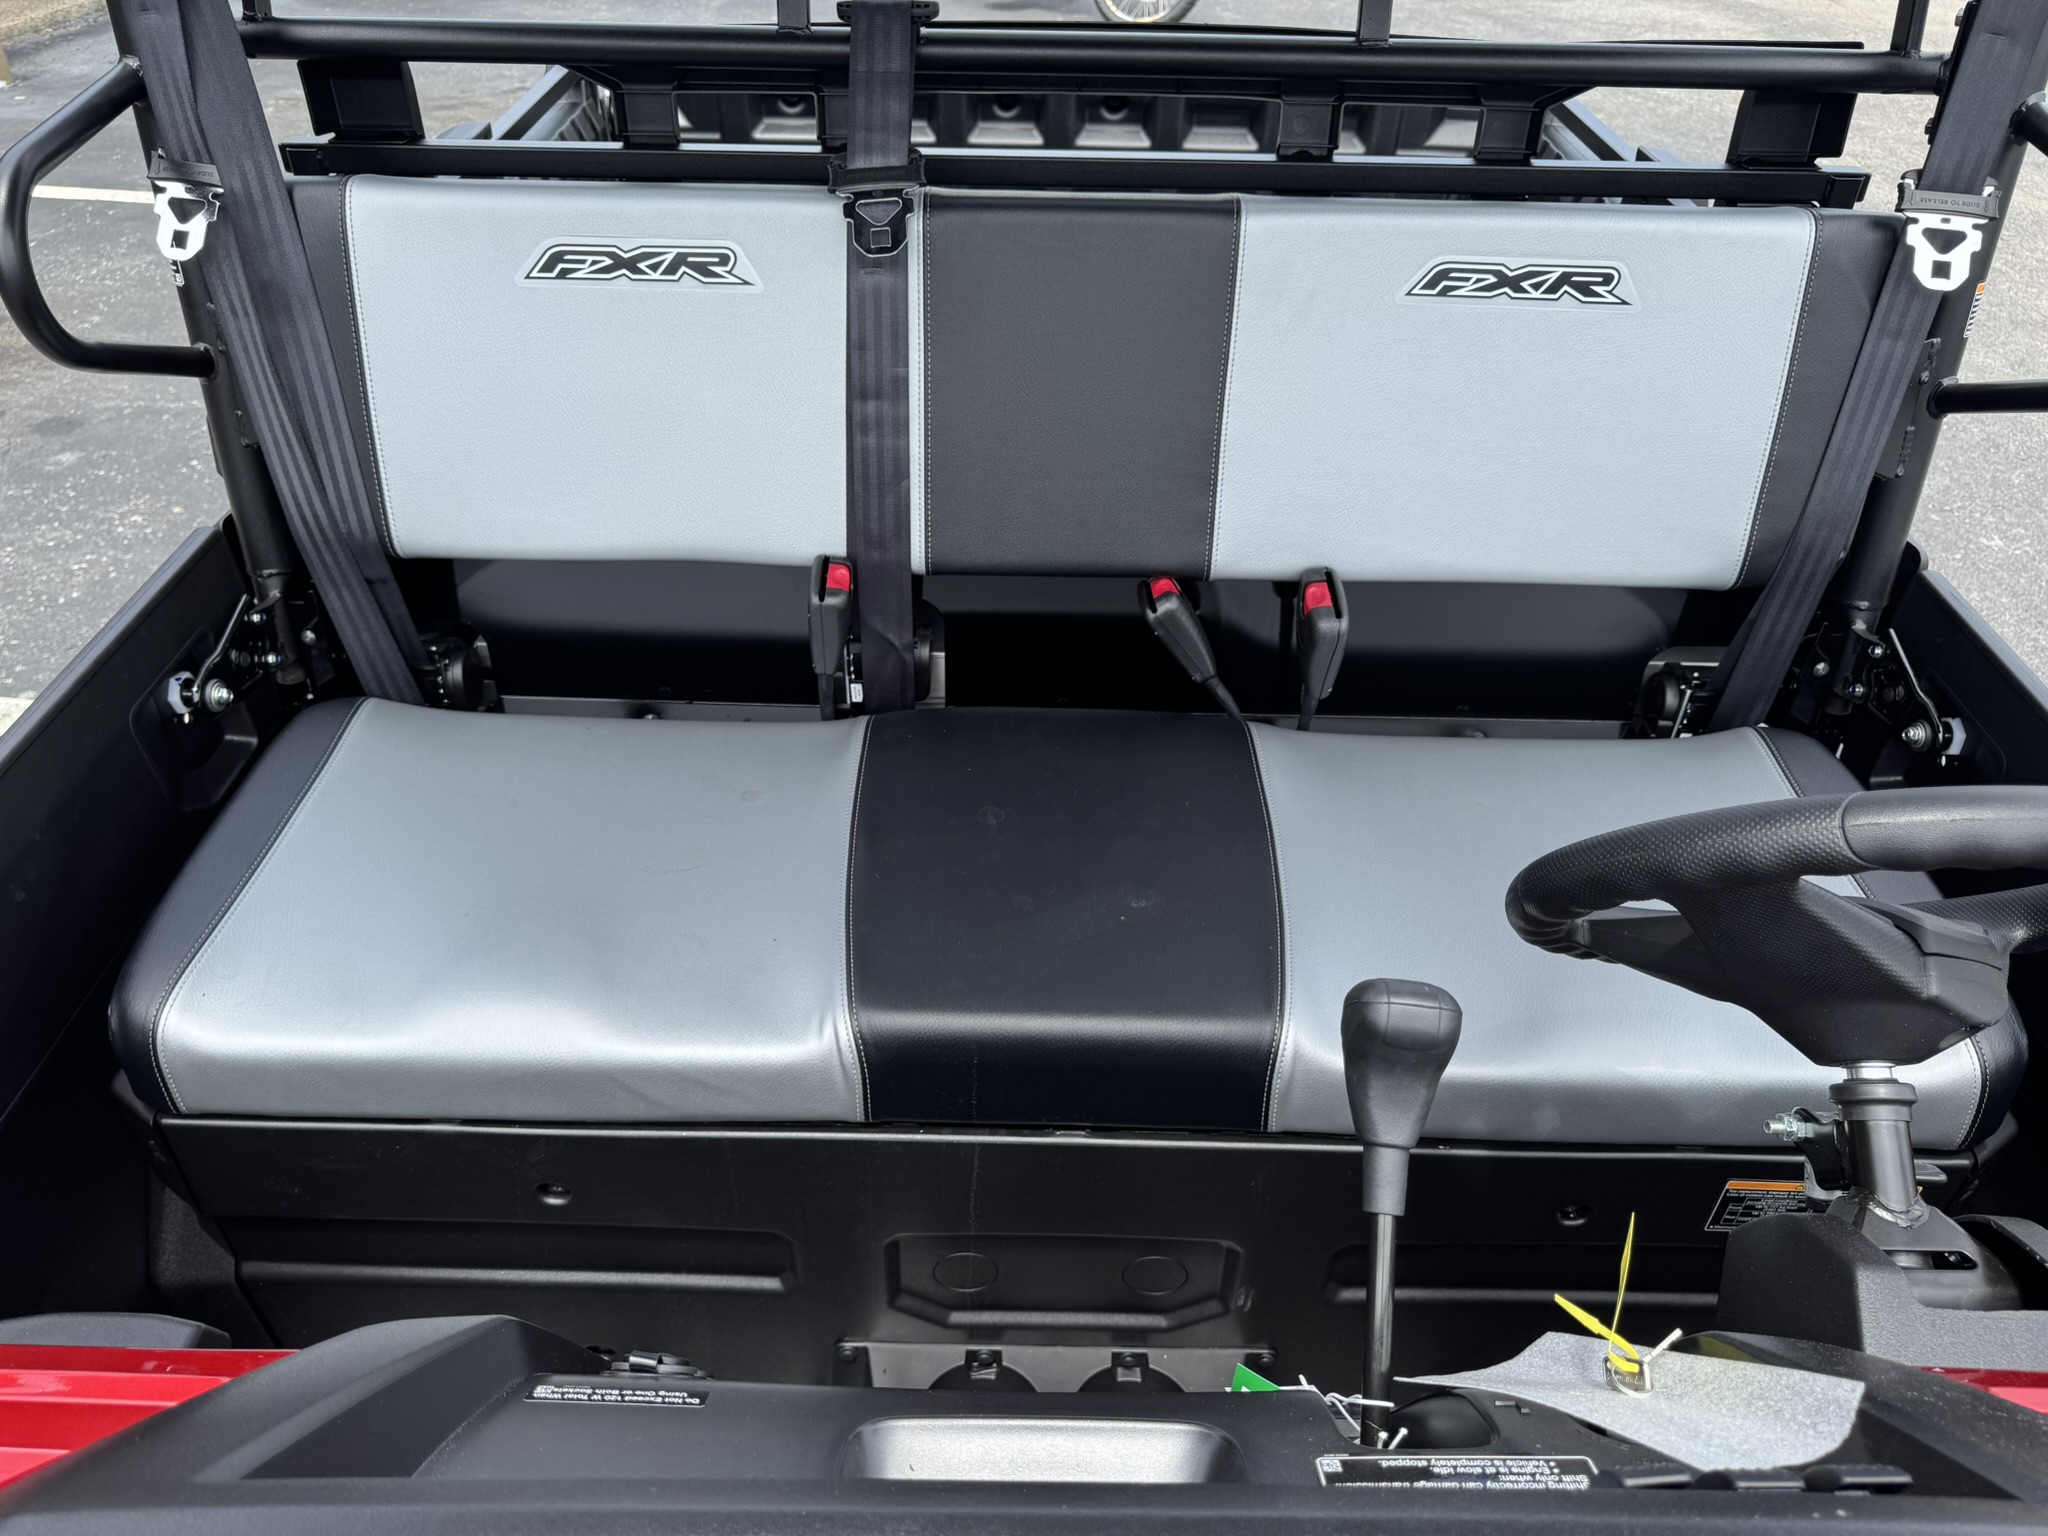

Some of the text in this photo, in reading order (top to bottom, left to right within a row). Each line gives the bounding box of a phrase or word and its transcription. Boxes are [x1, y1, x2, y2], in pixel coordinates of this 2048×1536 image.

[1919, 196, 1949, 205] RELEASE
[524, 243, 755, 286] FXR
[1404, 260, 1632, 305] FXR
[532, 1392, 562, 1400] When
[1378, 1459, 1428, 1468] stopped.
[1430, 1458, 1491, 1467] completely
[1505, 1459, 1547, 1467] Vehicle
[1429, 1466, 1454, 1475] idle.
[1456, 1466, 1483, 1474] slow
[1511, 1466, 1550, 1474] Engine
[1498, 1473, 1589, 1482] Shift only when:
